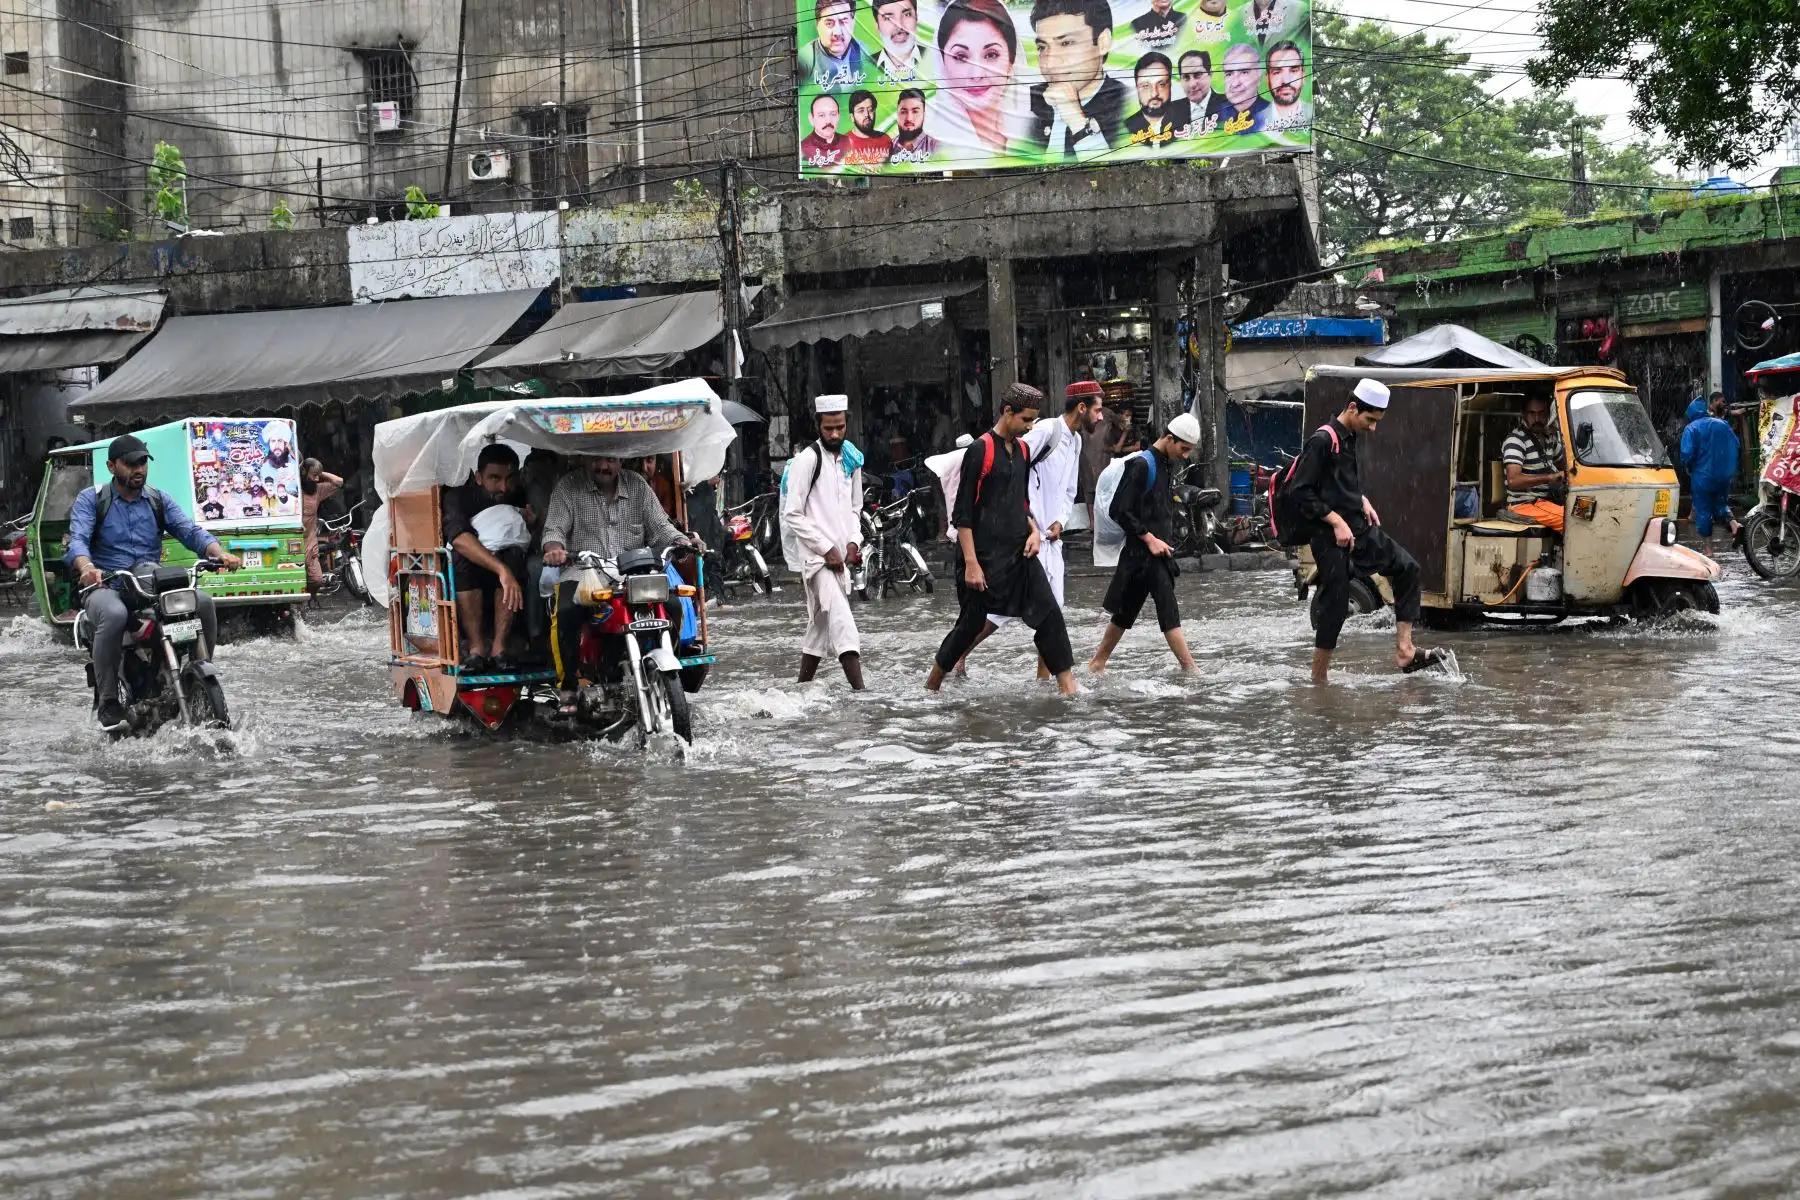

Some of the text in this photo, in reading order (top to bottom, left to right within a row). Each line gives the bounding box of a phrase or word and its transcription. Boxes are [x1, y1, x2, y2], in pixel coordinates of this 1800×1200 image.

[1195, 20, 1212, 33] تاج
[828, 66, 848, 91] قیصر
[877, 68, 901, 86] ریاض
[1174, 113, 1219, 140] جمیل شریف
[890, 148, 911, 165] عثمان
[910, 149, 930, 163] میاں
[1256, 321, 1281, 336] قادری
[195, 425, 205, 437] 12
[230, 443, 263, 463] جلوس
